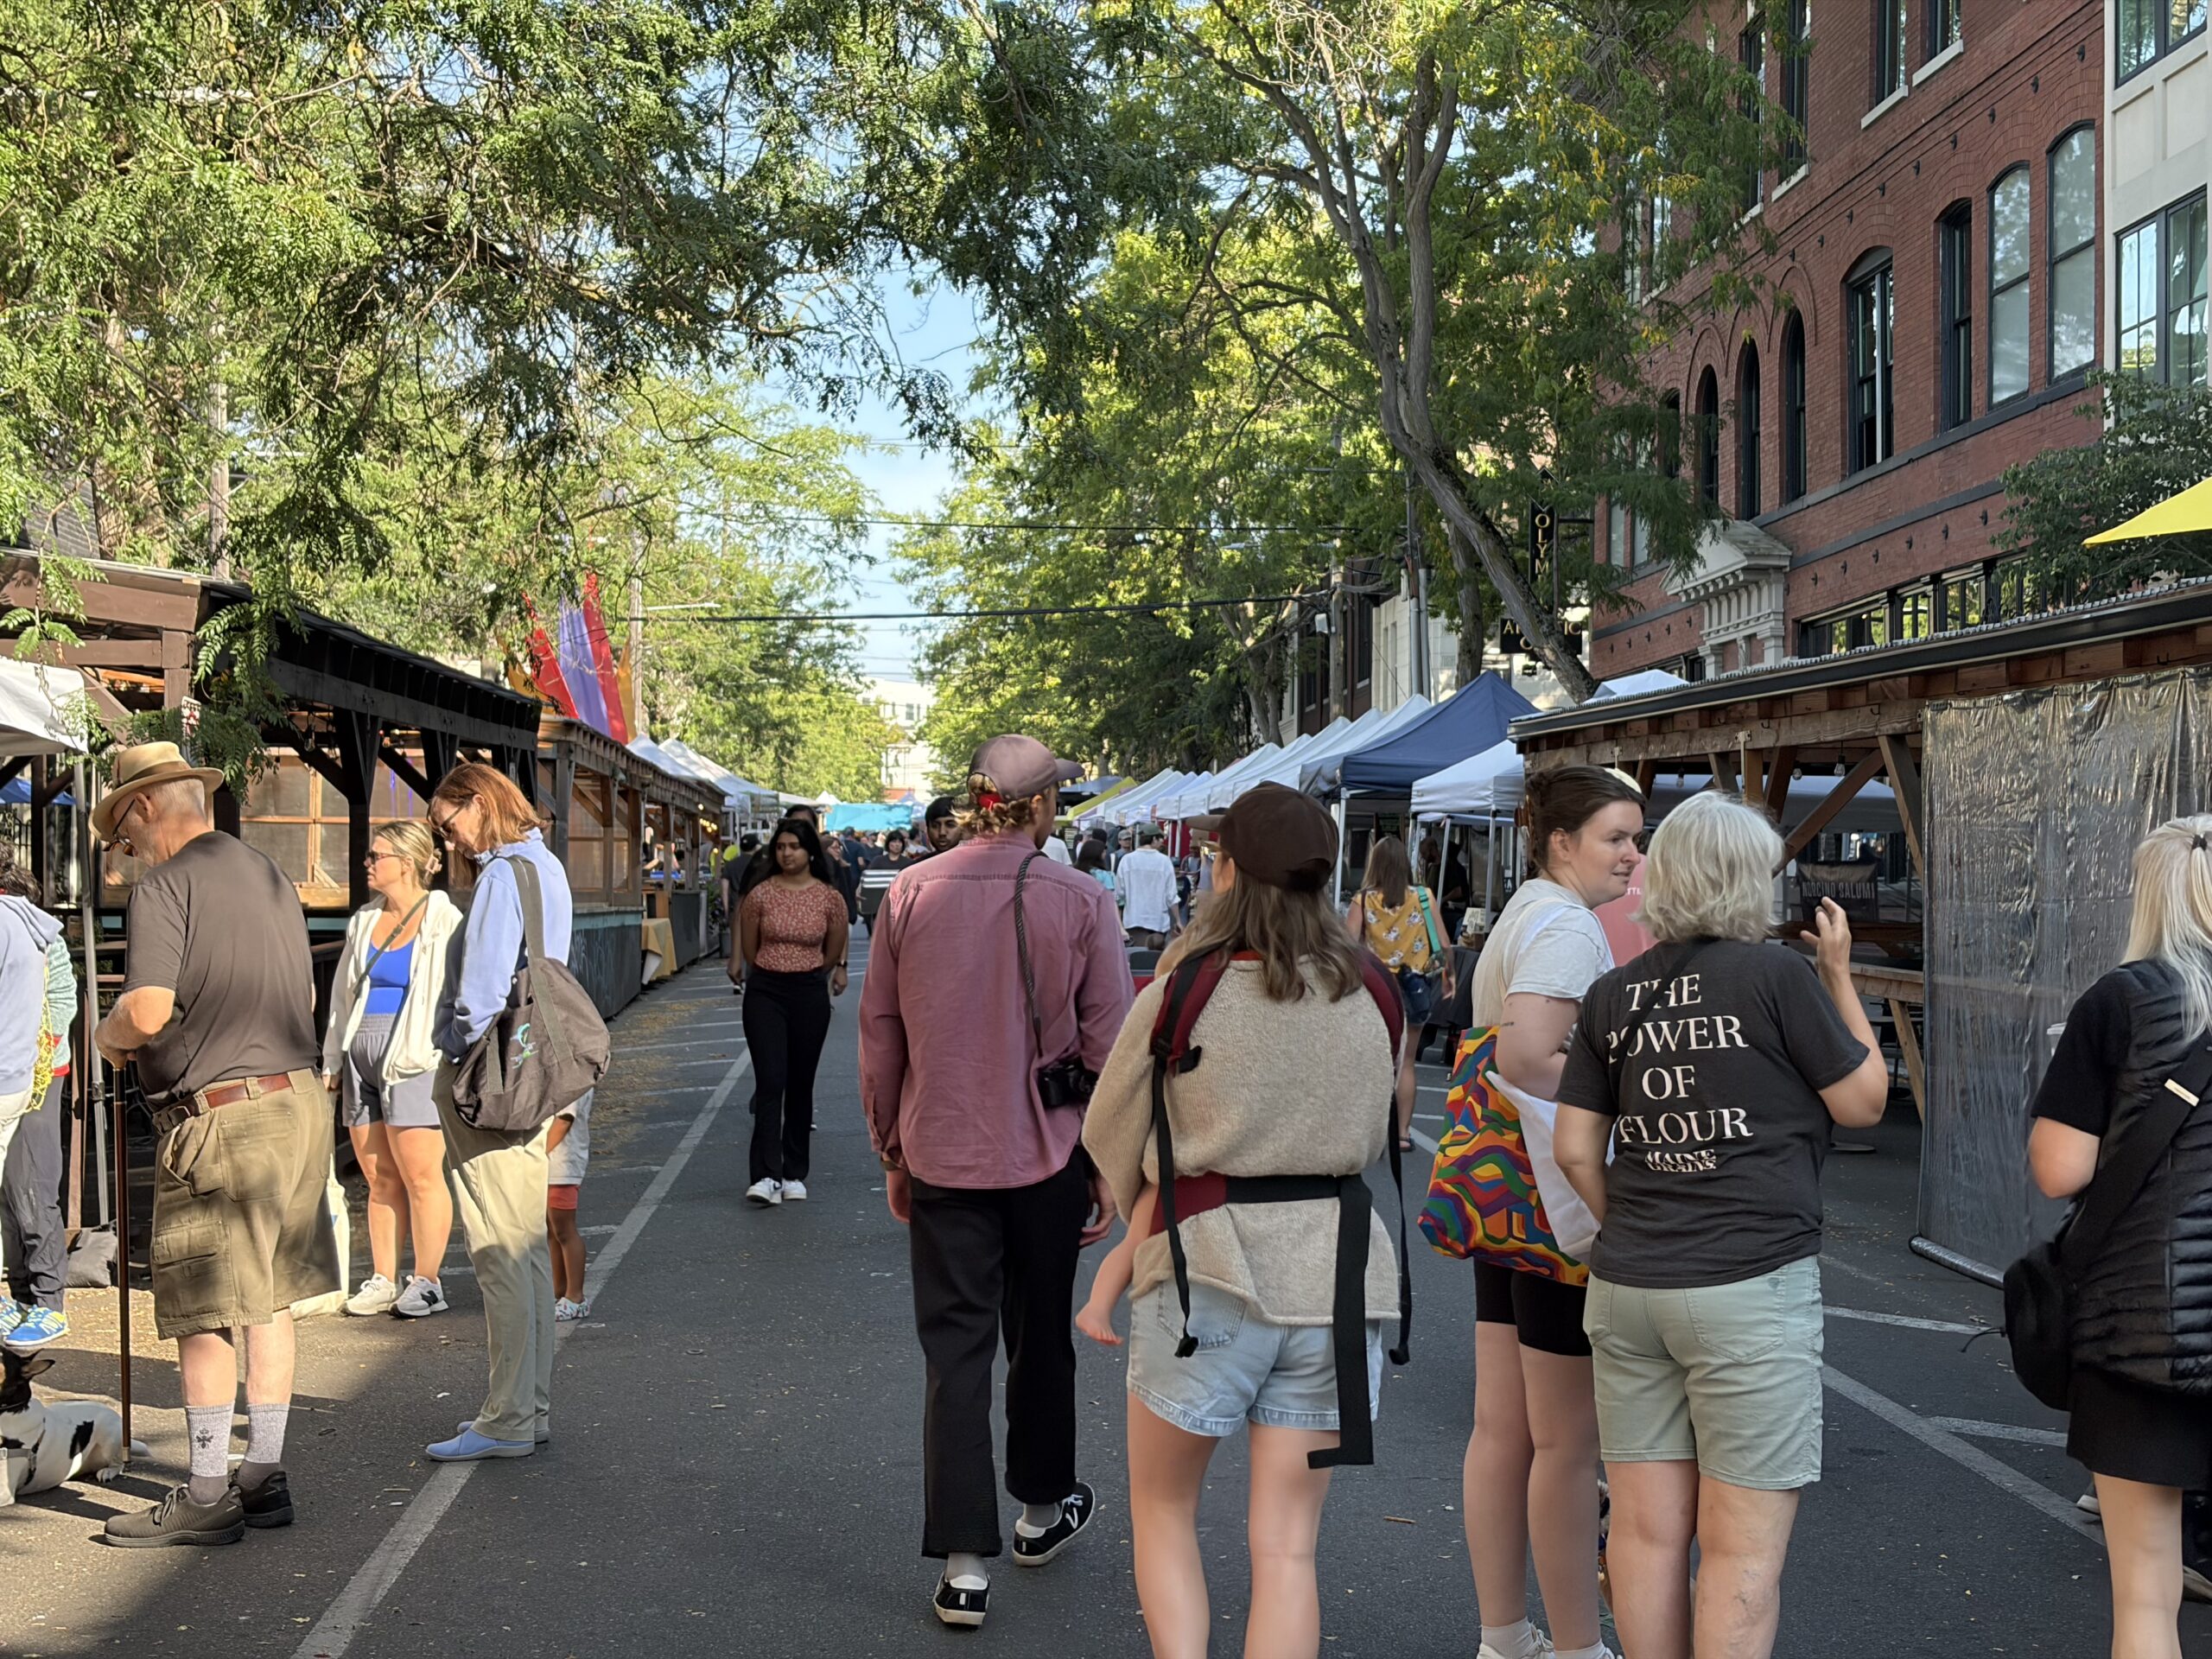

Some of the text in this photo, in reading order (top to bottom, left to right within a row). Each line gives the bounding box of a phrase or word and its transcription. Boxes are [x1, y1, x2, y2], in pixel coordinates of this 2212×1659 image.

[1535, 513, 1551, 586] OLYM
[1839, 881, 1875, 899] SALUMI
[1625, 974, 1702, 1012] THE
[1605, 1014, 1750, 1065] POWER
[1642, 1065, 1695, 1100] OF
[1618, 1107, 1755, 1144] FLOUR
